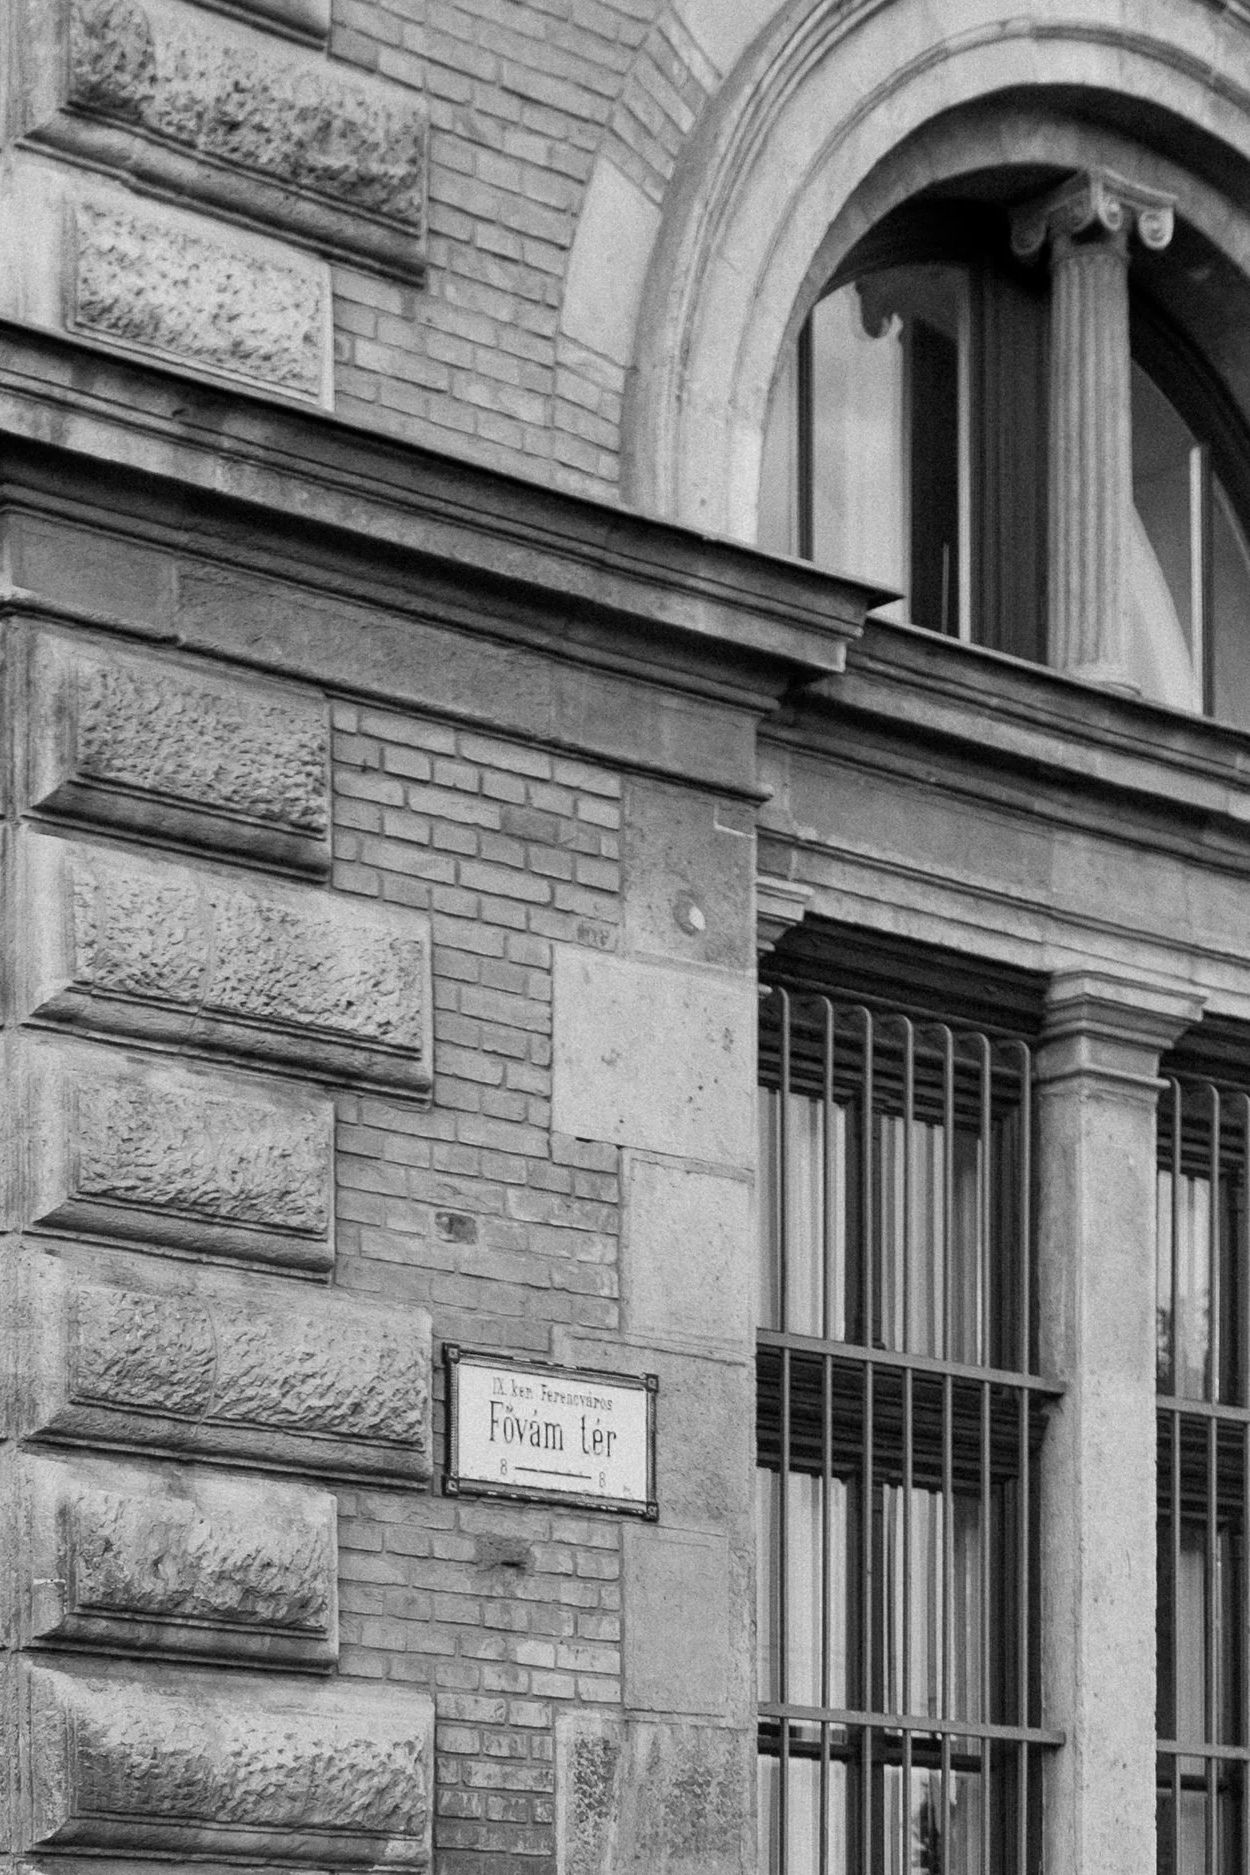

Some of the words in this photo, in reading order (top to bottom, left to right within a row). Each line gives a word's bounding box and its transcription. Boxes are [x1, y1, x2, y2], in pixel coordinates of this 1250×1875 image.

[541, 1383, 613, 1411] Ferencváros
[489, 1400, 564, 1451] Fővám
[581, 1414, 617, 1458] tér
